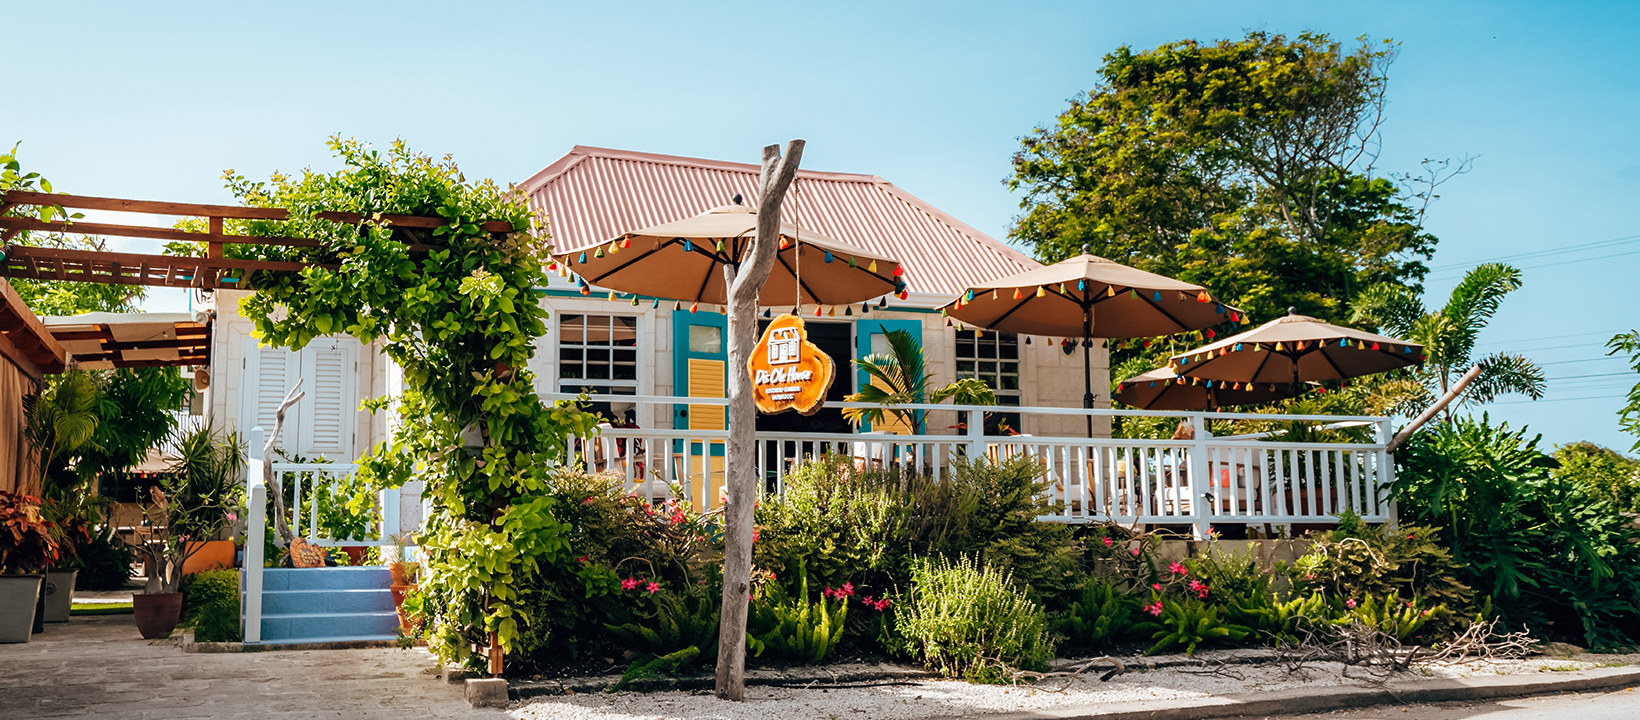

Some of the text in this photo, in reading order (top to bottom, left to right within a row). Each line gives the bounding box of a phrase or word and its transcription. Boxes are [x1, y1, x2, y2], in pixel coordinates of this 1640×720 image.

[755, 366, 812, 384] Dis Ole House
